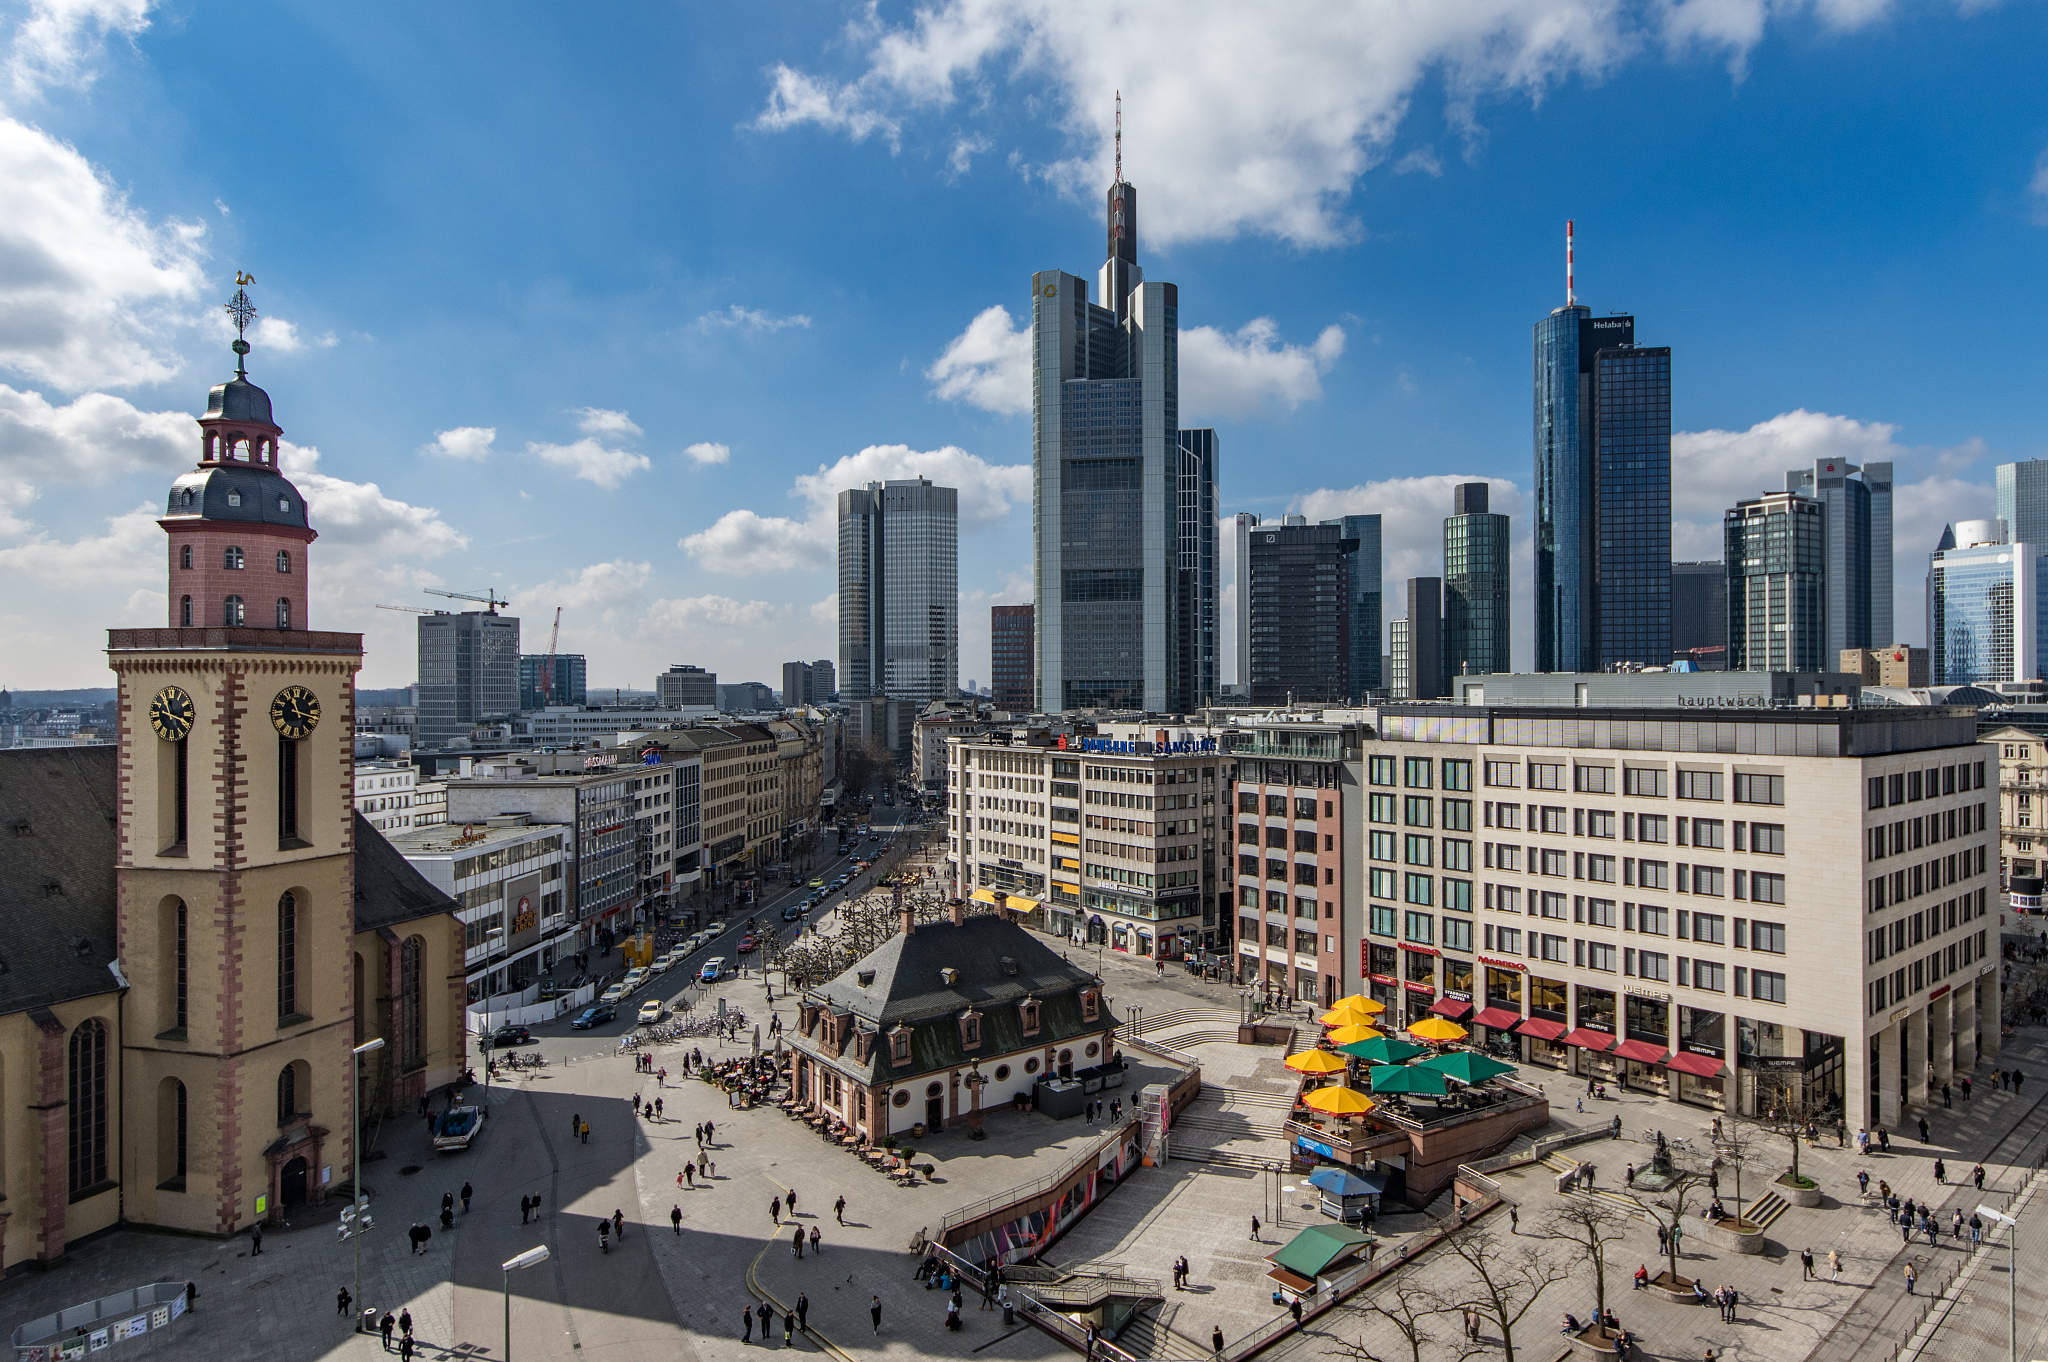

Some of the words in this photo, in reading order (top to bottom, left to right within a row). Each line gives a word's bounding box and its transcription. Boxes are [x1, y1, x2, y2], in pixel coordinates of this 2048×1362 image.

[1594, 321, 1622, 329] Helaba
[1678, 695, 1775, 708] hauptwache
[1083, 738, 1135, 753] SAMSUNG
[1155, 740, 1217, 754] SAMSUNG
[644, 816, 654, 861] HOTEL
[515, 910, 537, 925] SPORT
[514, 921, 537, 934] ARENA
[1397, 942, 1441, 957] MAREDO
[1478, 955, 1527, 971] MAREDO
[1982, 963, 1995, 975] GEOX
[1444, 989, 1470, 1000] STARBUCKS
[1449, 994, 1466, 1003] COFFEE
[1622, 984, 1671, 1001] WEMPE
[1585, 1021, 1609, 1032] WEMPE
[1689, 1044, 1716, 1056] WEMPE
